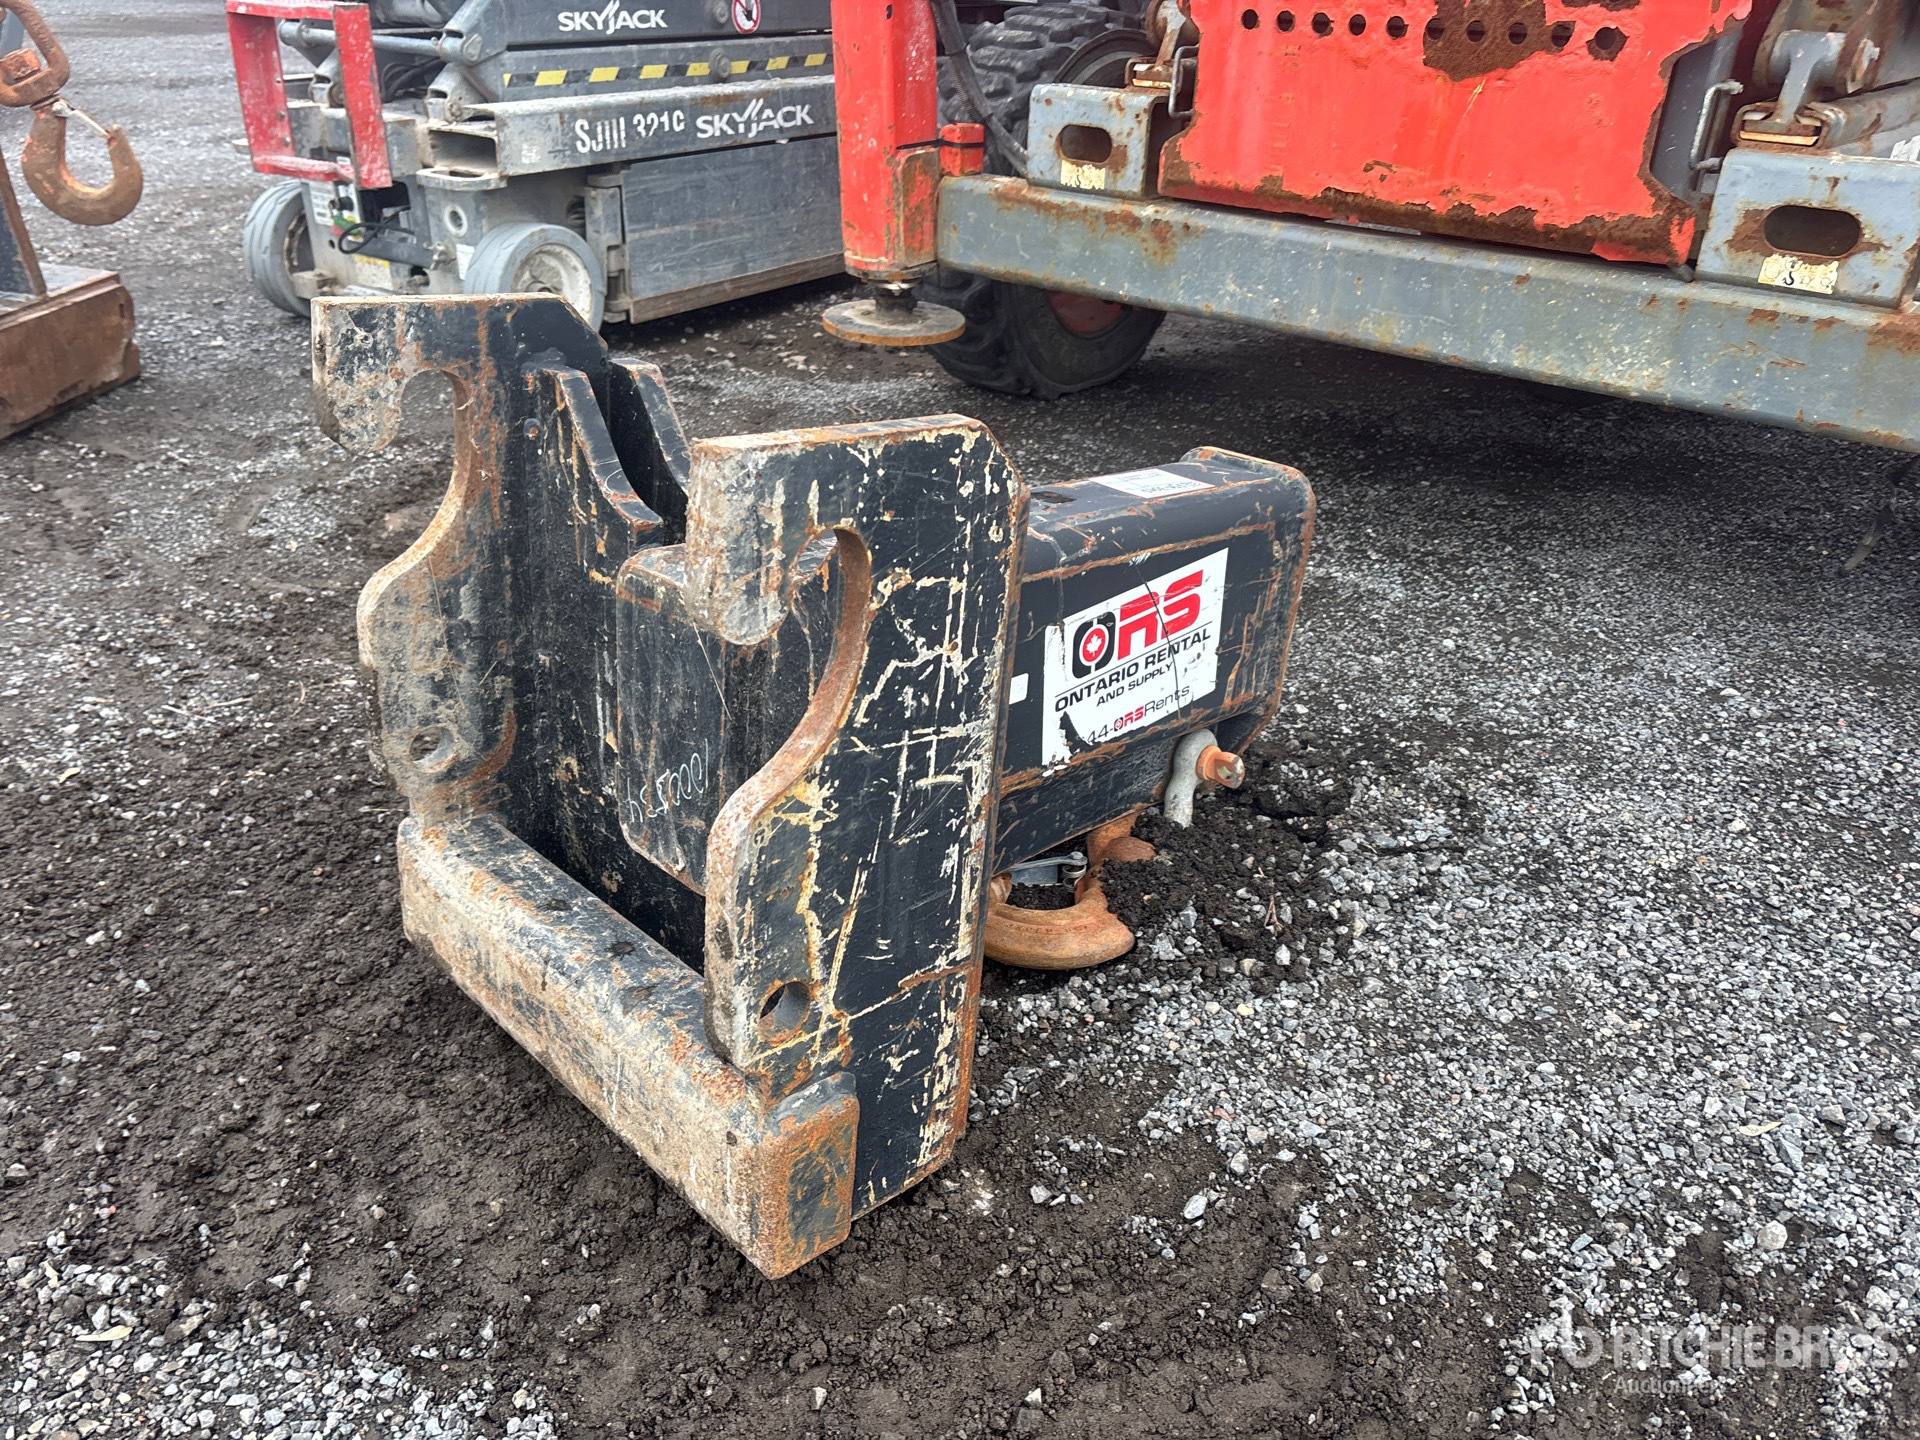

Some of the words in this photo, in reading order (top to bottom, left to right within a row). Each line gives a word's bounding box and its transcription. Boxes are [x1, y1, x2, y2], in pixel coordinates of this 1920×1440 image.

[558, 0, 668, 34] SKYJACK
[696, 98, 815, 138] SKYJACK
[1072, 569, 1204, 679] ORS
[1055, 661, 1139, 712] ONTARIO
[1144, 628, 1211, 670] RENTAL
[1096, 686, 1125, 708] AND
[1128, 661, 1173, 691] SUPPLY
